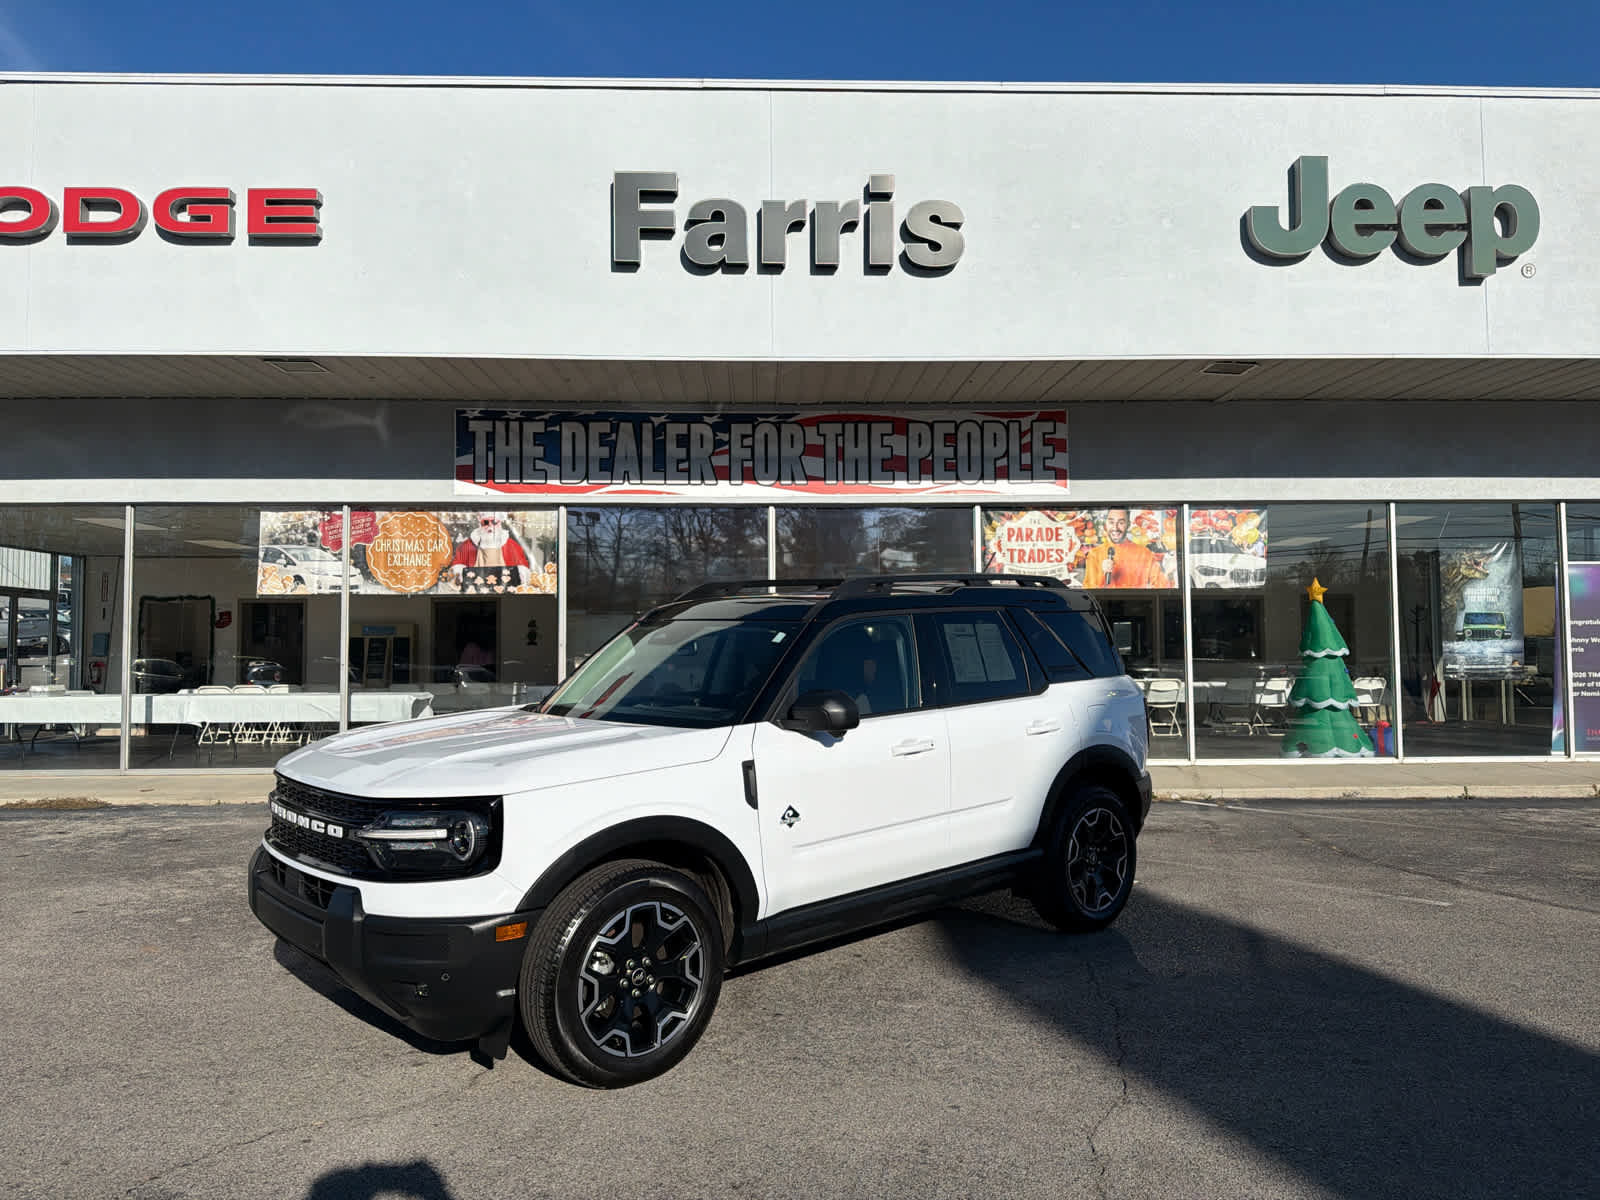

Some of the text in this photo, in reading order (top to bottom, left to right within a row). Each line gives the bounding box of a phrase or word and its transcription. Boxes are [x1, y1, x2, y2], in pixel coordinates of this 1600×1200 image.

[610, 171, 965, 276] Farris
[1241, 155, 1540, 286] Jeep
[468, 420, 1056, 486] THE DEALER FOR THE PEOPLE
[375, 538, 445, 552] CHRISTMAS CAR
[1007, 527, 1064, 542] PARADE
[387, 553, 433, 567] EXCHANGE
[1006, 548, 1065, 563] TRADES
[271, 801, 343, 838] BRONCO
